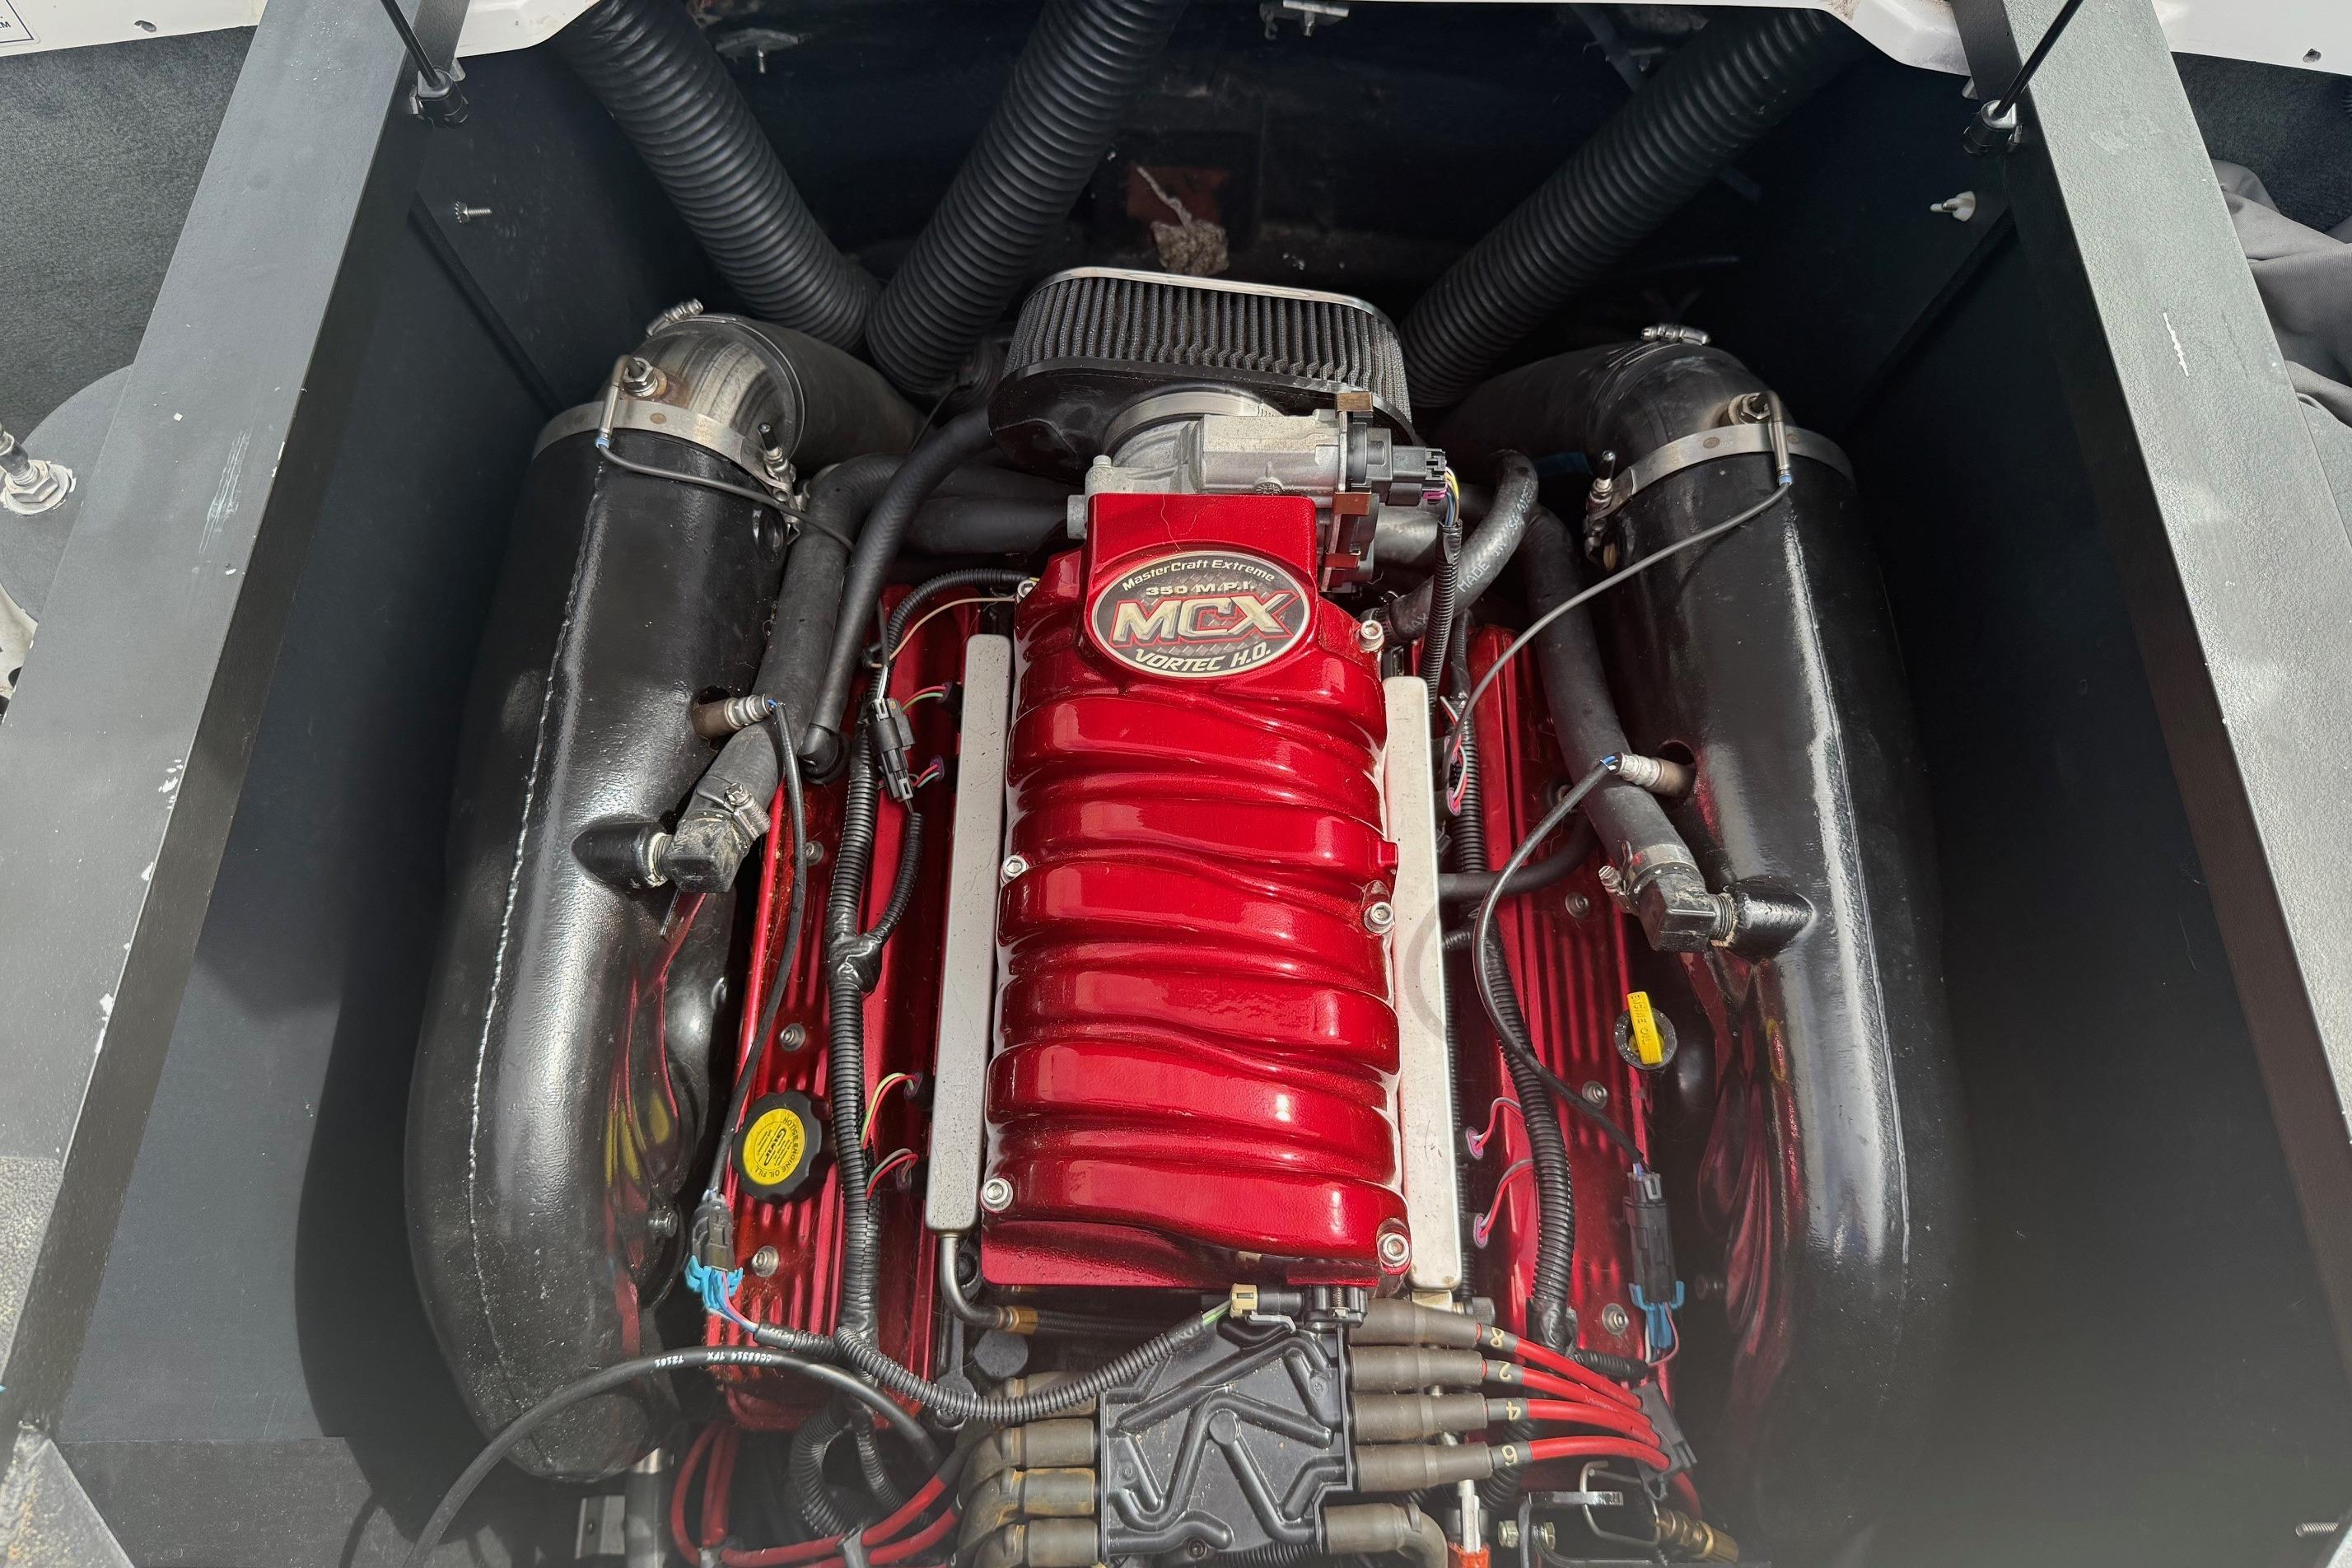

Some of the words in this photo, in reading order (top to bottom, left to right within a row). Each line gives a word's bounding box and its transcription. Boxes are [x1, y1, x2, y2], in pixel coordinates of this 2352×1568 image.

[1122, 559, 1209, 591] MasterCraft
[1211, 559, 1275, 582] Extreme
[1457, 562, 1491, 592] MADE
[1146, 585, 1188, 596] 350
[1109, 590, 1297, 647] MCX
[1135, 648, 1227, 673] VORTEC
[1640, 1026, 1651, 1045] OIL
[782, 1116, 799, 1140] NOTICE
[754, 1166, 768, 1178] FILL
[769, 1169, 781, 1178] OIL
[1490, 1327, 1505, 1348] 8
[1499, 1361, 1512, 1381] 2
[1506, 1401, 1521, 1421] 4
